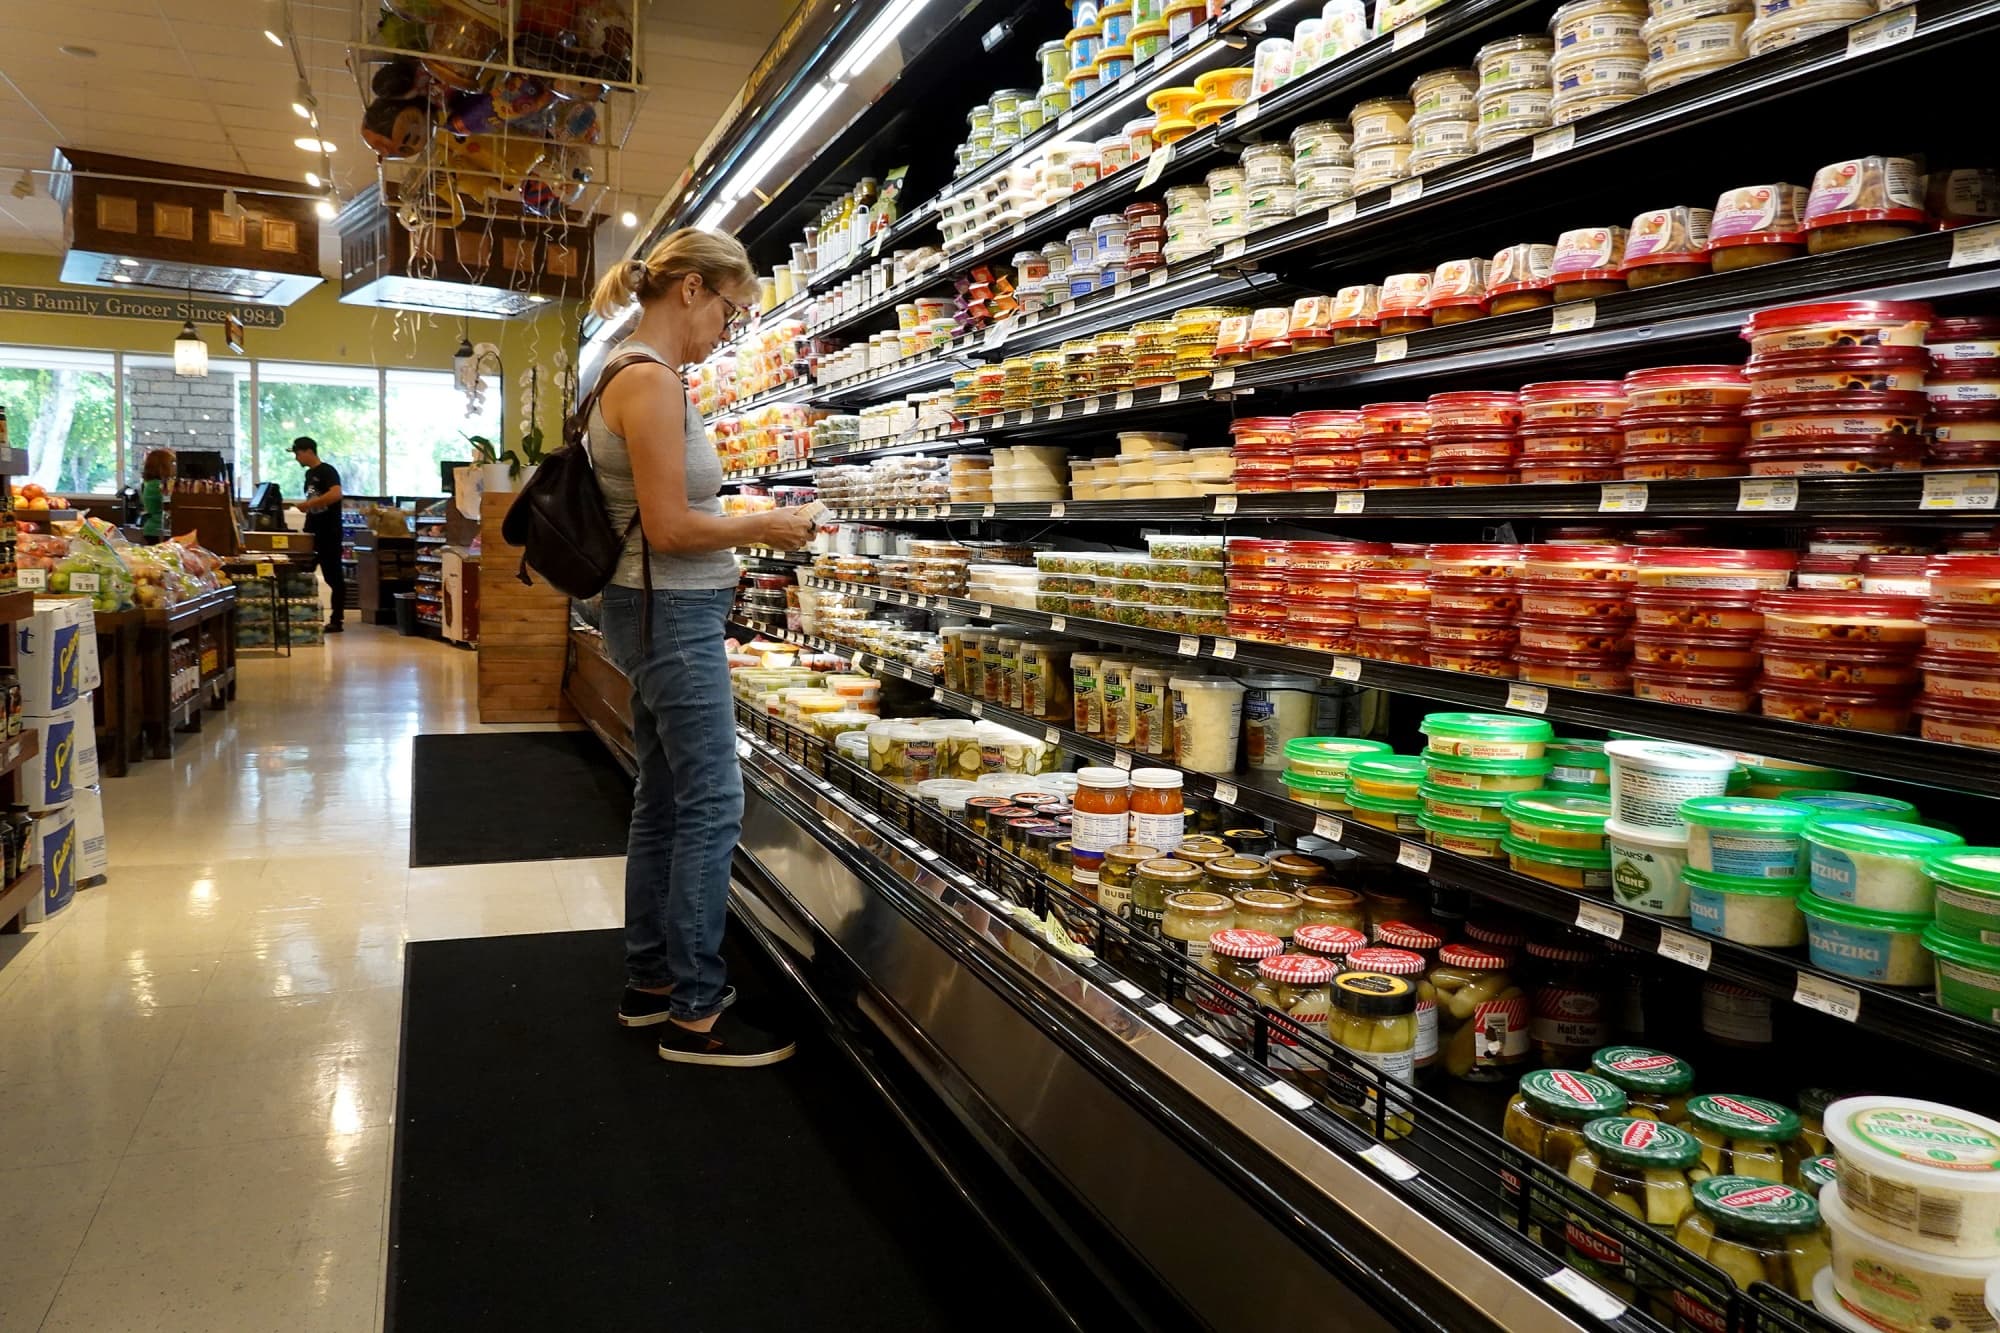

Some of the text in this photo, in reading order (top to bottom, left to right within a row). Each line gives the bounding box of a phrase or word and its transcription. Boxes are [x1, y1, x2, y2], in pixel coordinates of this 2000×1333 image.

[33, 293, 99, 318] Family
[106, 298, 172, 317] Grocer
[176, 303, 226, 321] Since
[235, 307, 277, 325] 1984
[1795, 423, 1835, 436] Sabra
[1950, 591, 1985, 600] Classic
[1955, 638, 1993, 648] Classic
[1669, 691, 1703, 705] Sabra
[1616, 873, 1646, 889] LABNE
[1557, 1023, 1576, 1035] Half
[1618, 1056, 1672, 1071] Claussen
[1714, 1097, 1776, 1124] Claussen
[1865, 1123, 1995, 1148] ROMANO
[1726, 1187, 1787, 1206] Claussen
